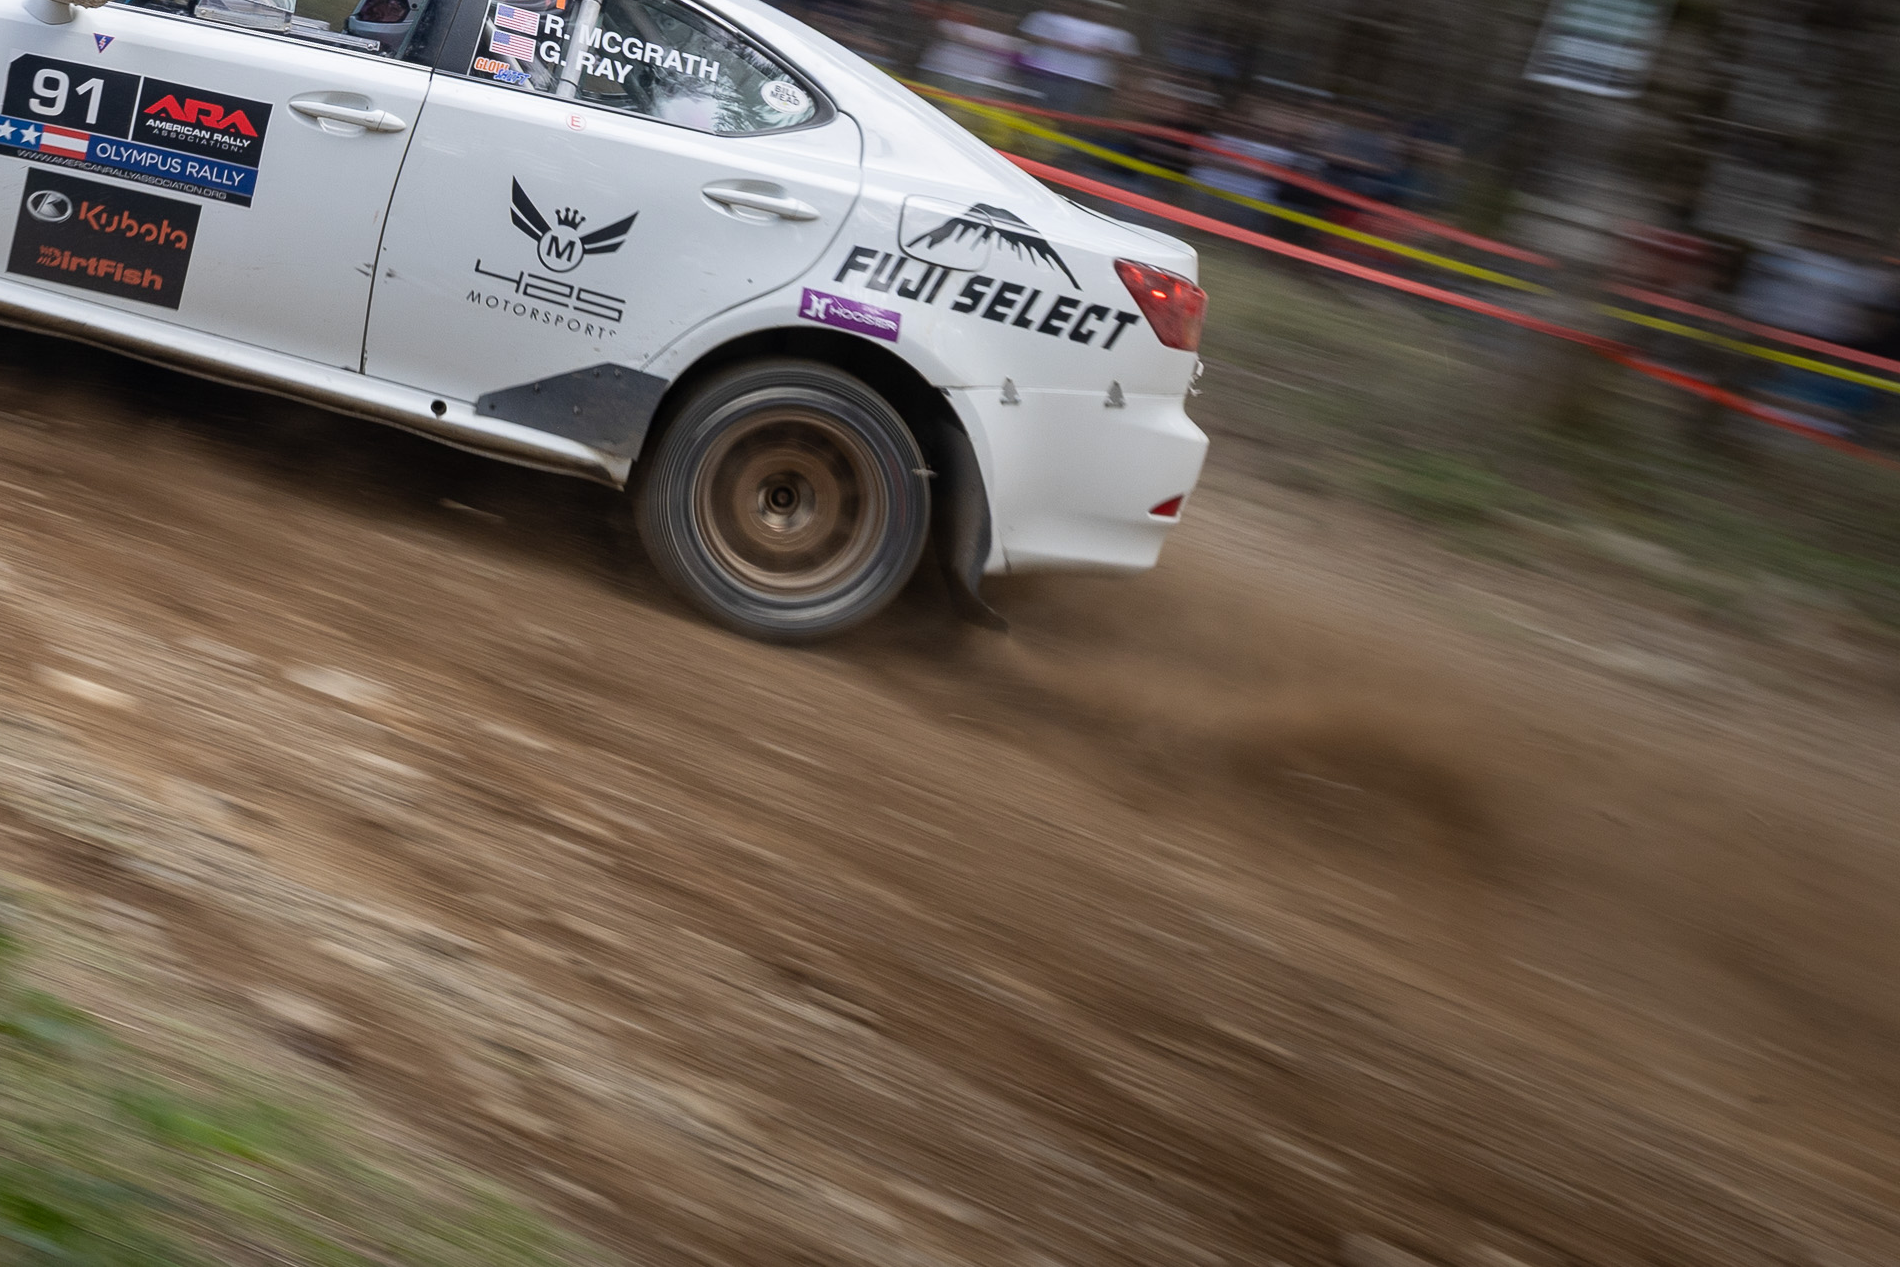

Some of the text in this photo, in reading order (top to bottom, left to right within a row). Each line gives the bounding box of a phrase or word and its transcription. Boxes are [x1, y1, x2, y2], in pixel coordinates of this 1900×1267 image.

[474, 56, 510, 74] GLOW
[539, 41, 633, 85] G. RAY
[544, 13, 720, 82] R. MCGRATH
[28, 68, 105, 125] 91
[143, 94, 259, 138] ARA
[145, 118, 251, 148] AMERICAN RALLY
[96, 142, 245, 187] OLYMPUS RALLY
[78, 200, 188, 250] Kubota
[36, 244, 164, 290] DirtFish
[546, 235, 576, 263] M
[833, 245, 1141, 351] FUJI SELECT
